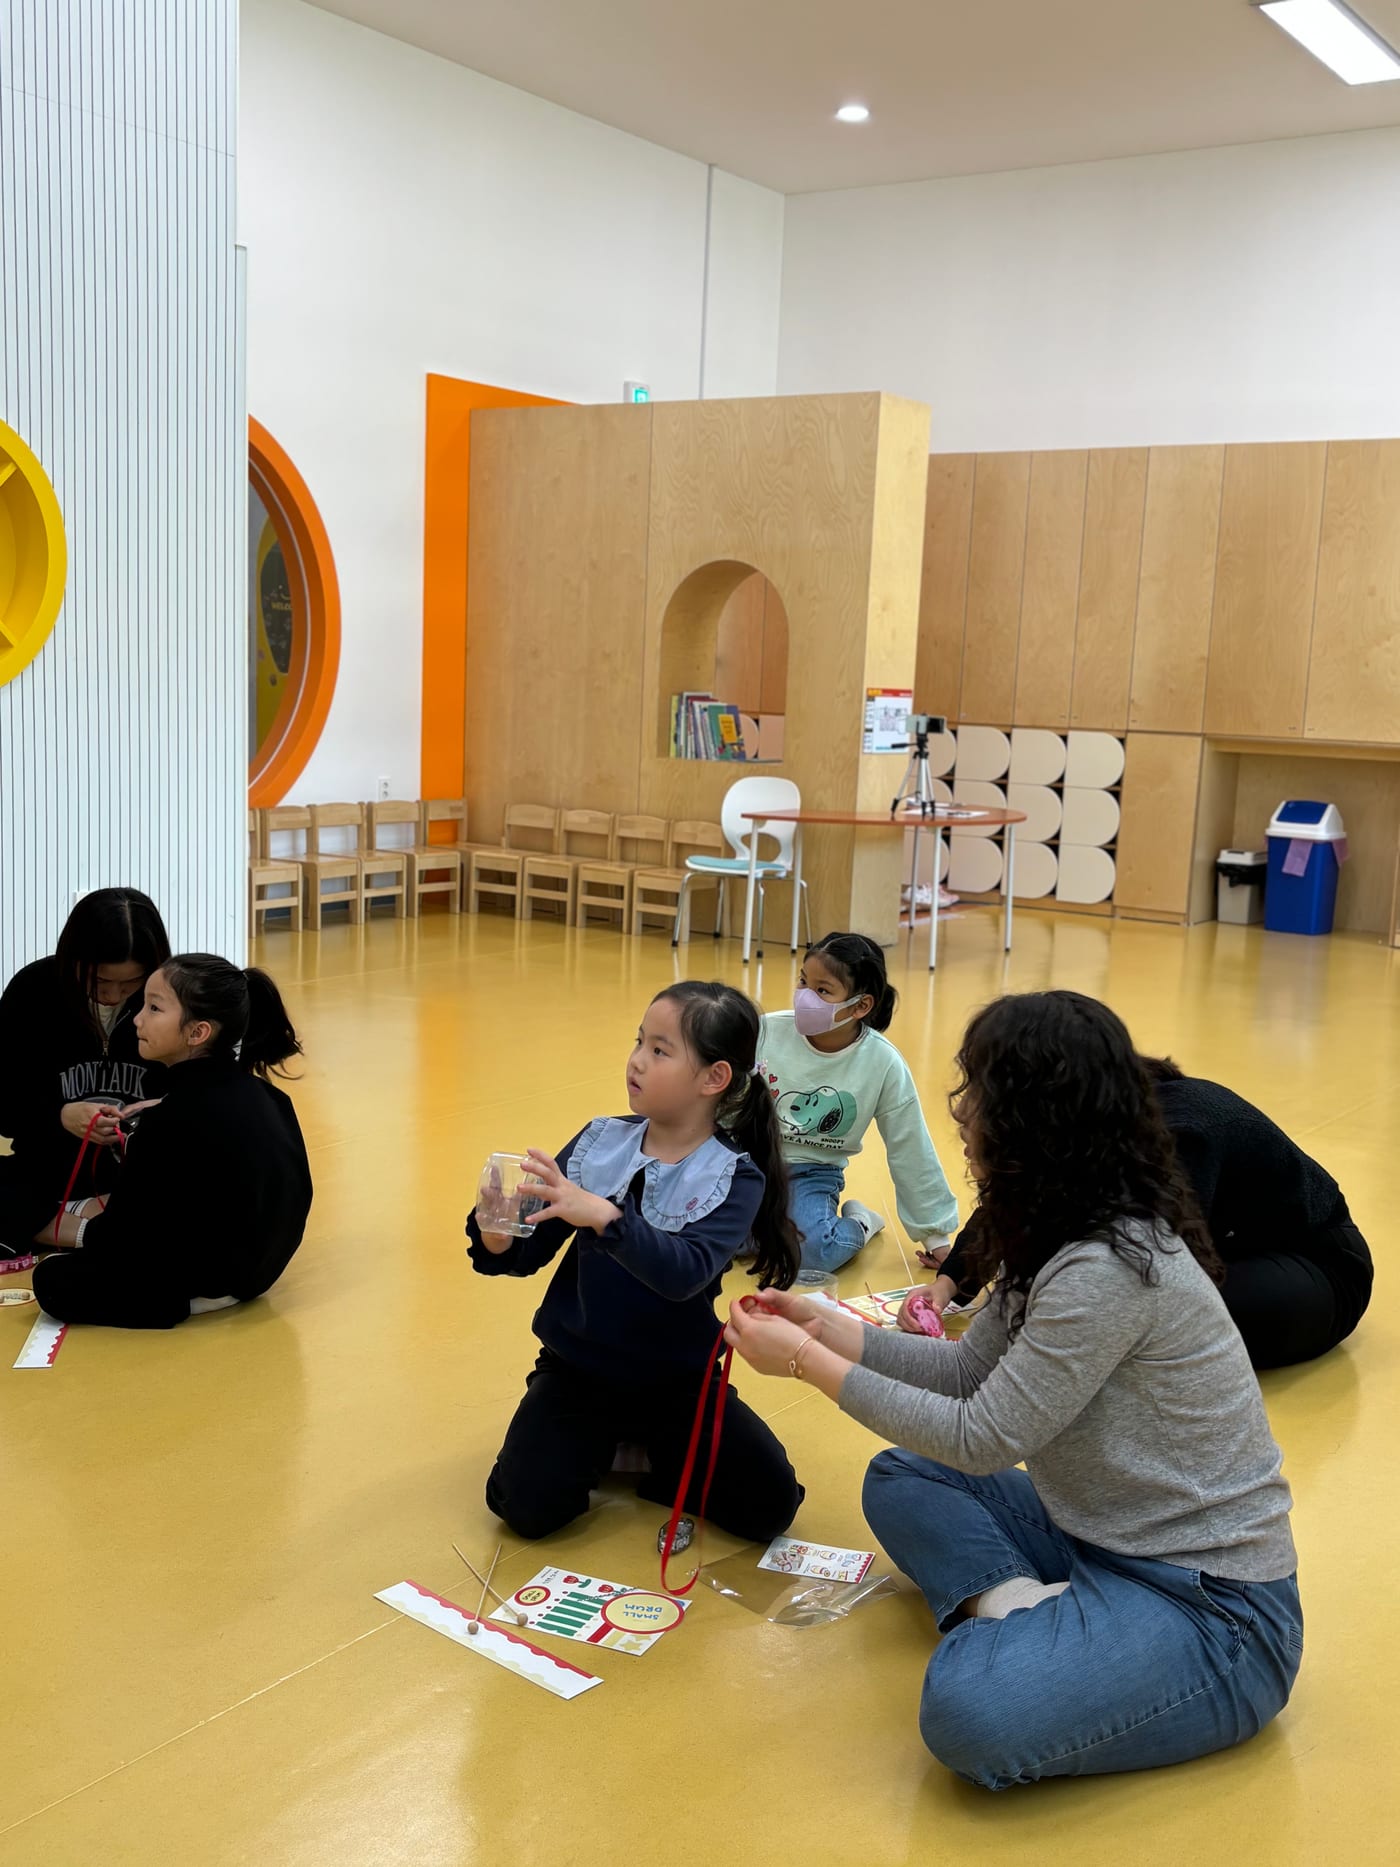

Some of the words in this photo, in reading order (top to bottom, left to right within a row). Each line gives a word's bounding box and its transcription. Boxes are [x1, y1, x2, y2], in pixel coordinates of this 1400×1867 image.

[59, 1060, 148, 1100] MONTAUK
[624, 1603, 663, 1613] DRUM
[623, 1611, 660, 1620] SMALL
